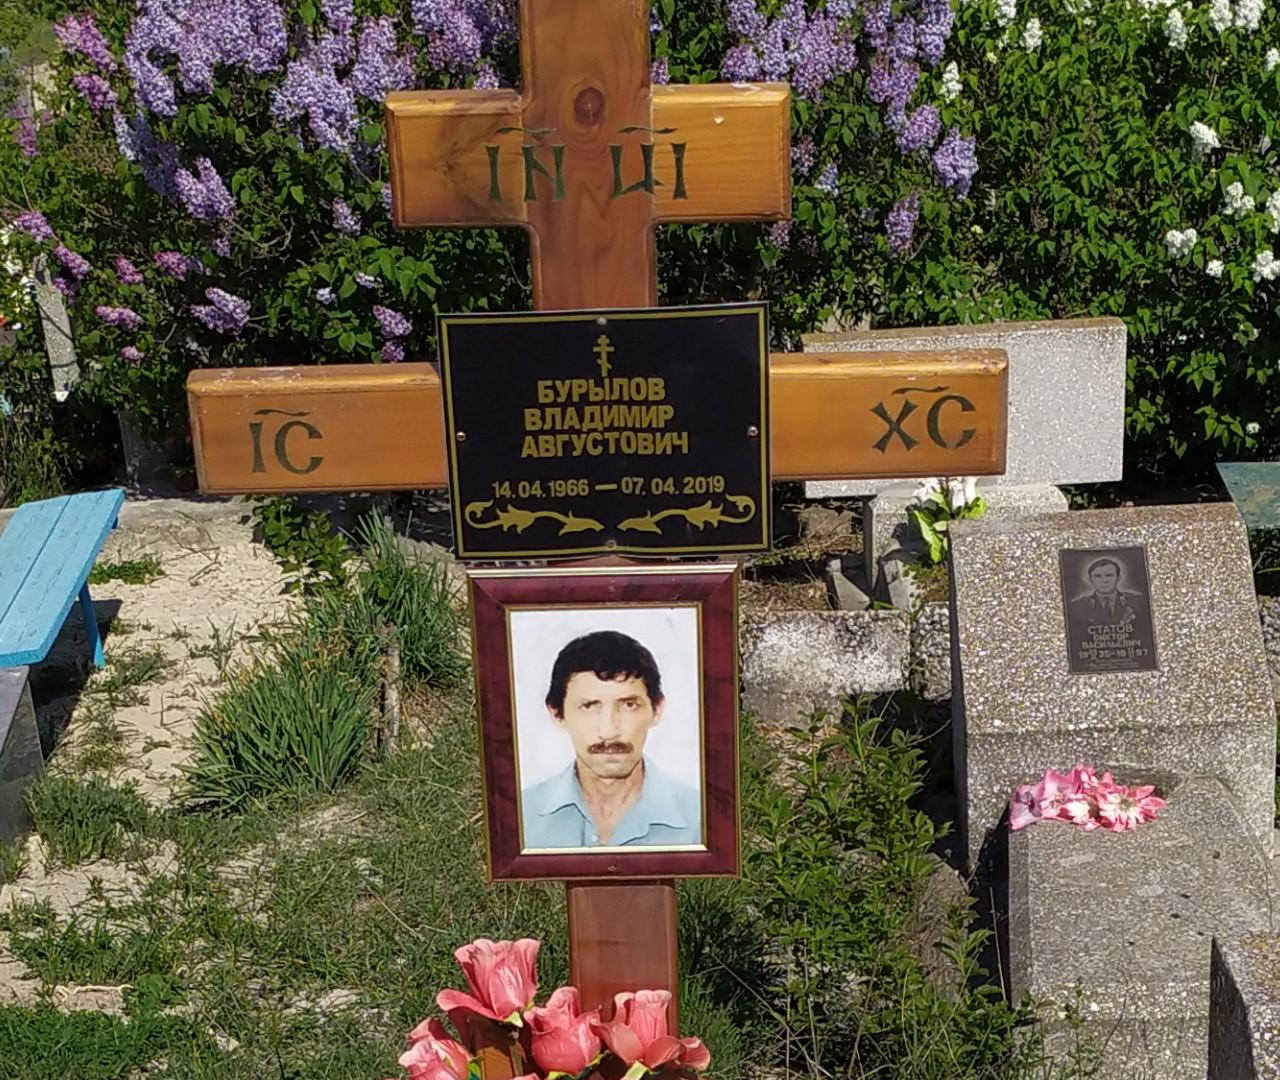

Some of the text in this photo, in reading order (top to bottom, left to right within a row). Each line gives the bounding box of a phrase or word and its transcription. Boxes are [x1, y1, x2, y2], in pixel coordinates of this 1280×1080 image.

[537, 377, 667, 404] БУРЫЛОВ
[524, 404, 675, 432] ВЛАДИМИР
[521, 431, 689, 458] АВГУСТОВИЧ
[492, 478, 589, 499] 14.04.1966
[1088, 624, 1133, 635] СТАТОВ
